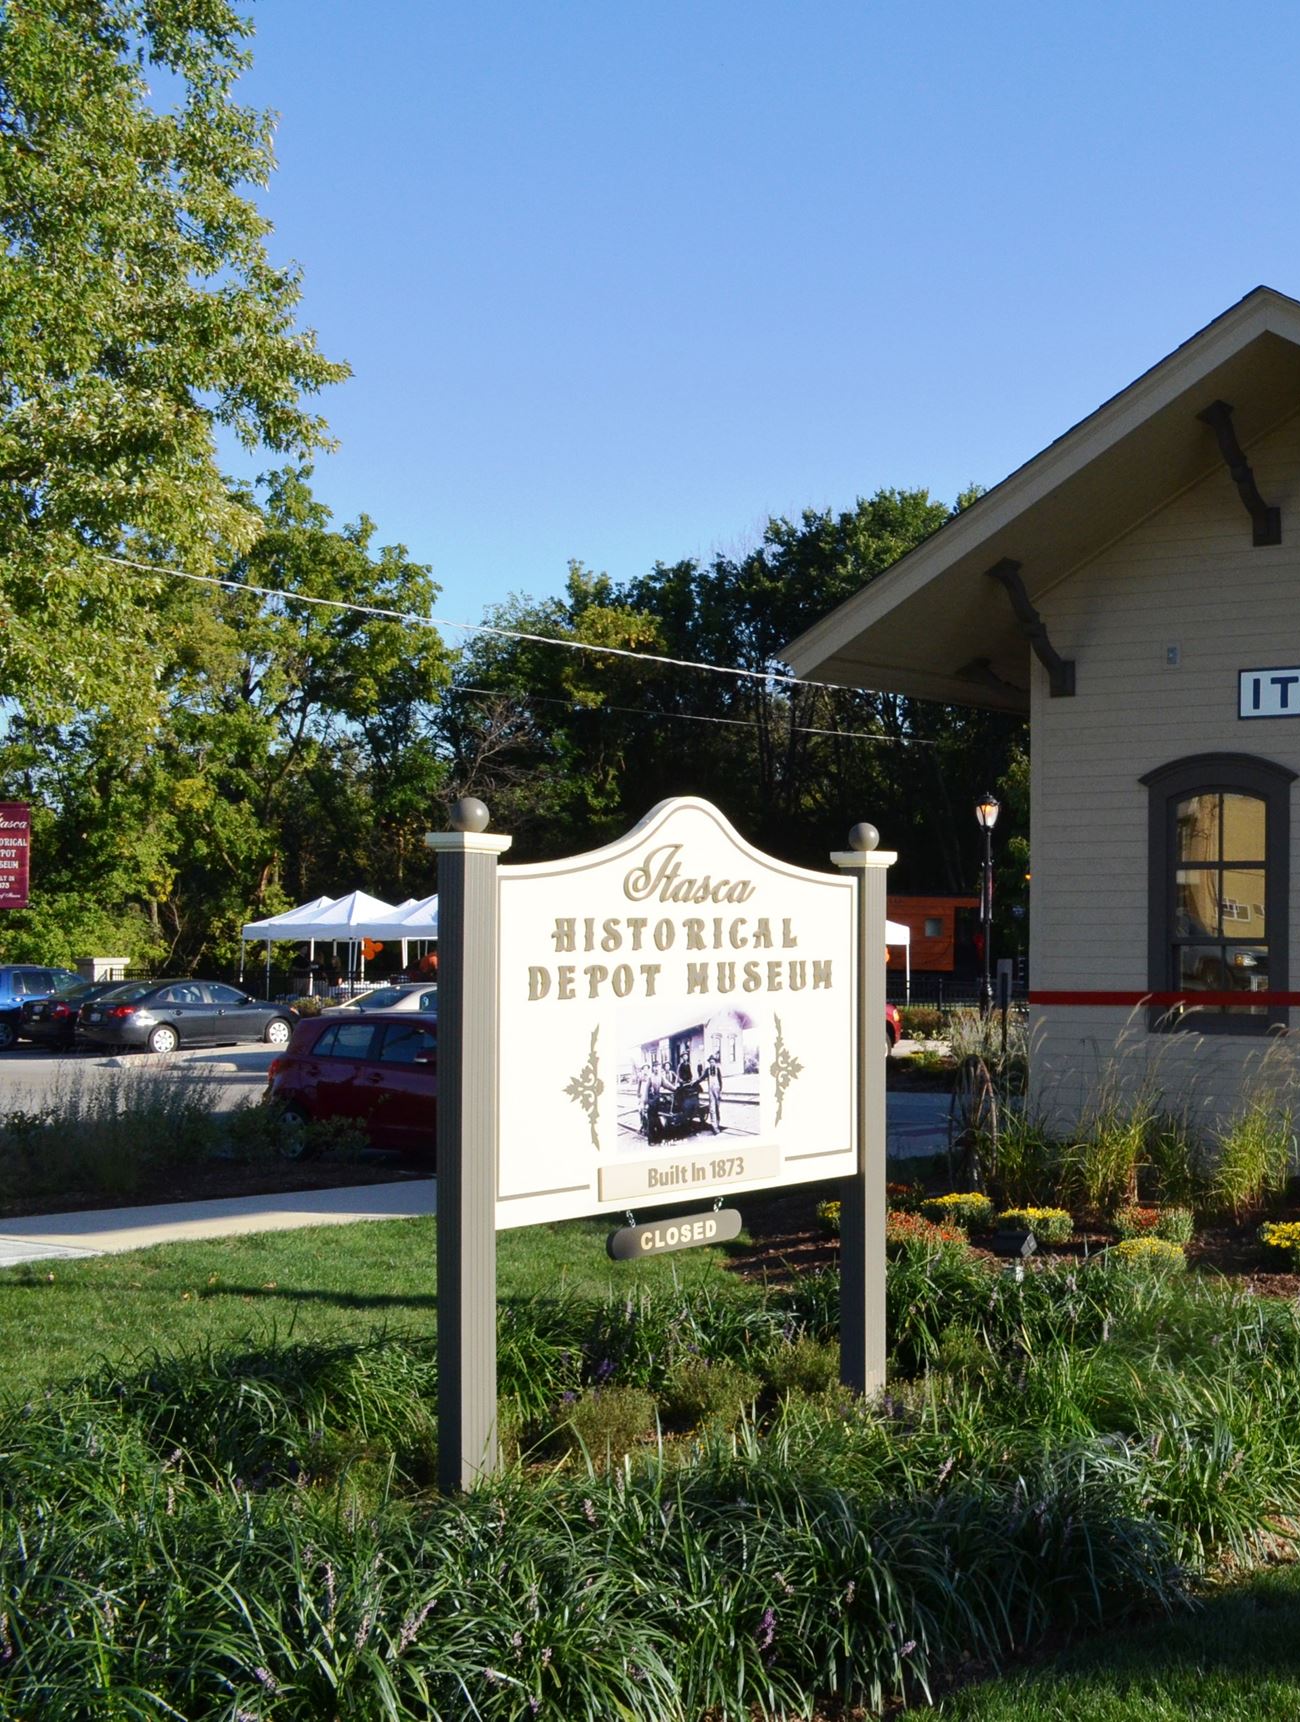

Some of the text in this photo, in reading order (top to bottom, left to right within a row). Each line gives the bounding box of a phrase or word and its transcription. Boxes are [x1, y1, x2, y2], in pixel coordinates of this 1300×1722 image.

[623, 843, 756, 904] Itasca
[551, 917, 798, 953] HISTORICAL
[527, 959, 833, 1001] DEPOT MUSEUM
[647, 1156, 745, 1188] Built In 1873
[640, 1219, 717, 1250] CLOSED
